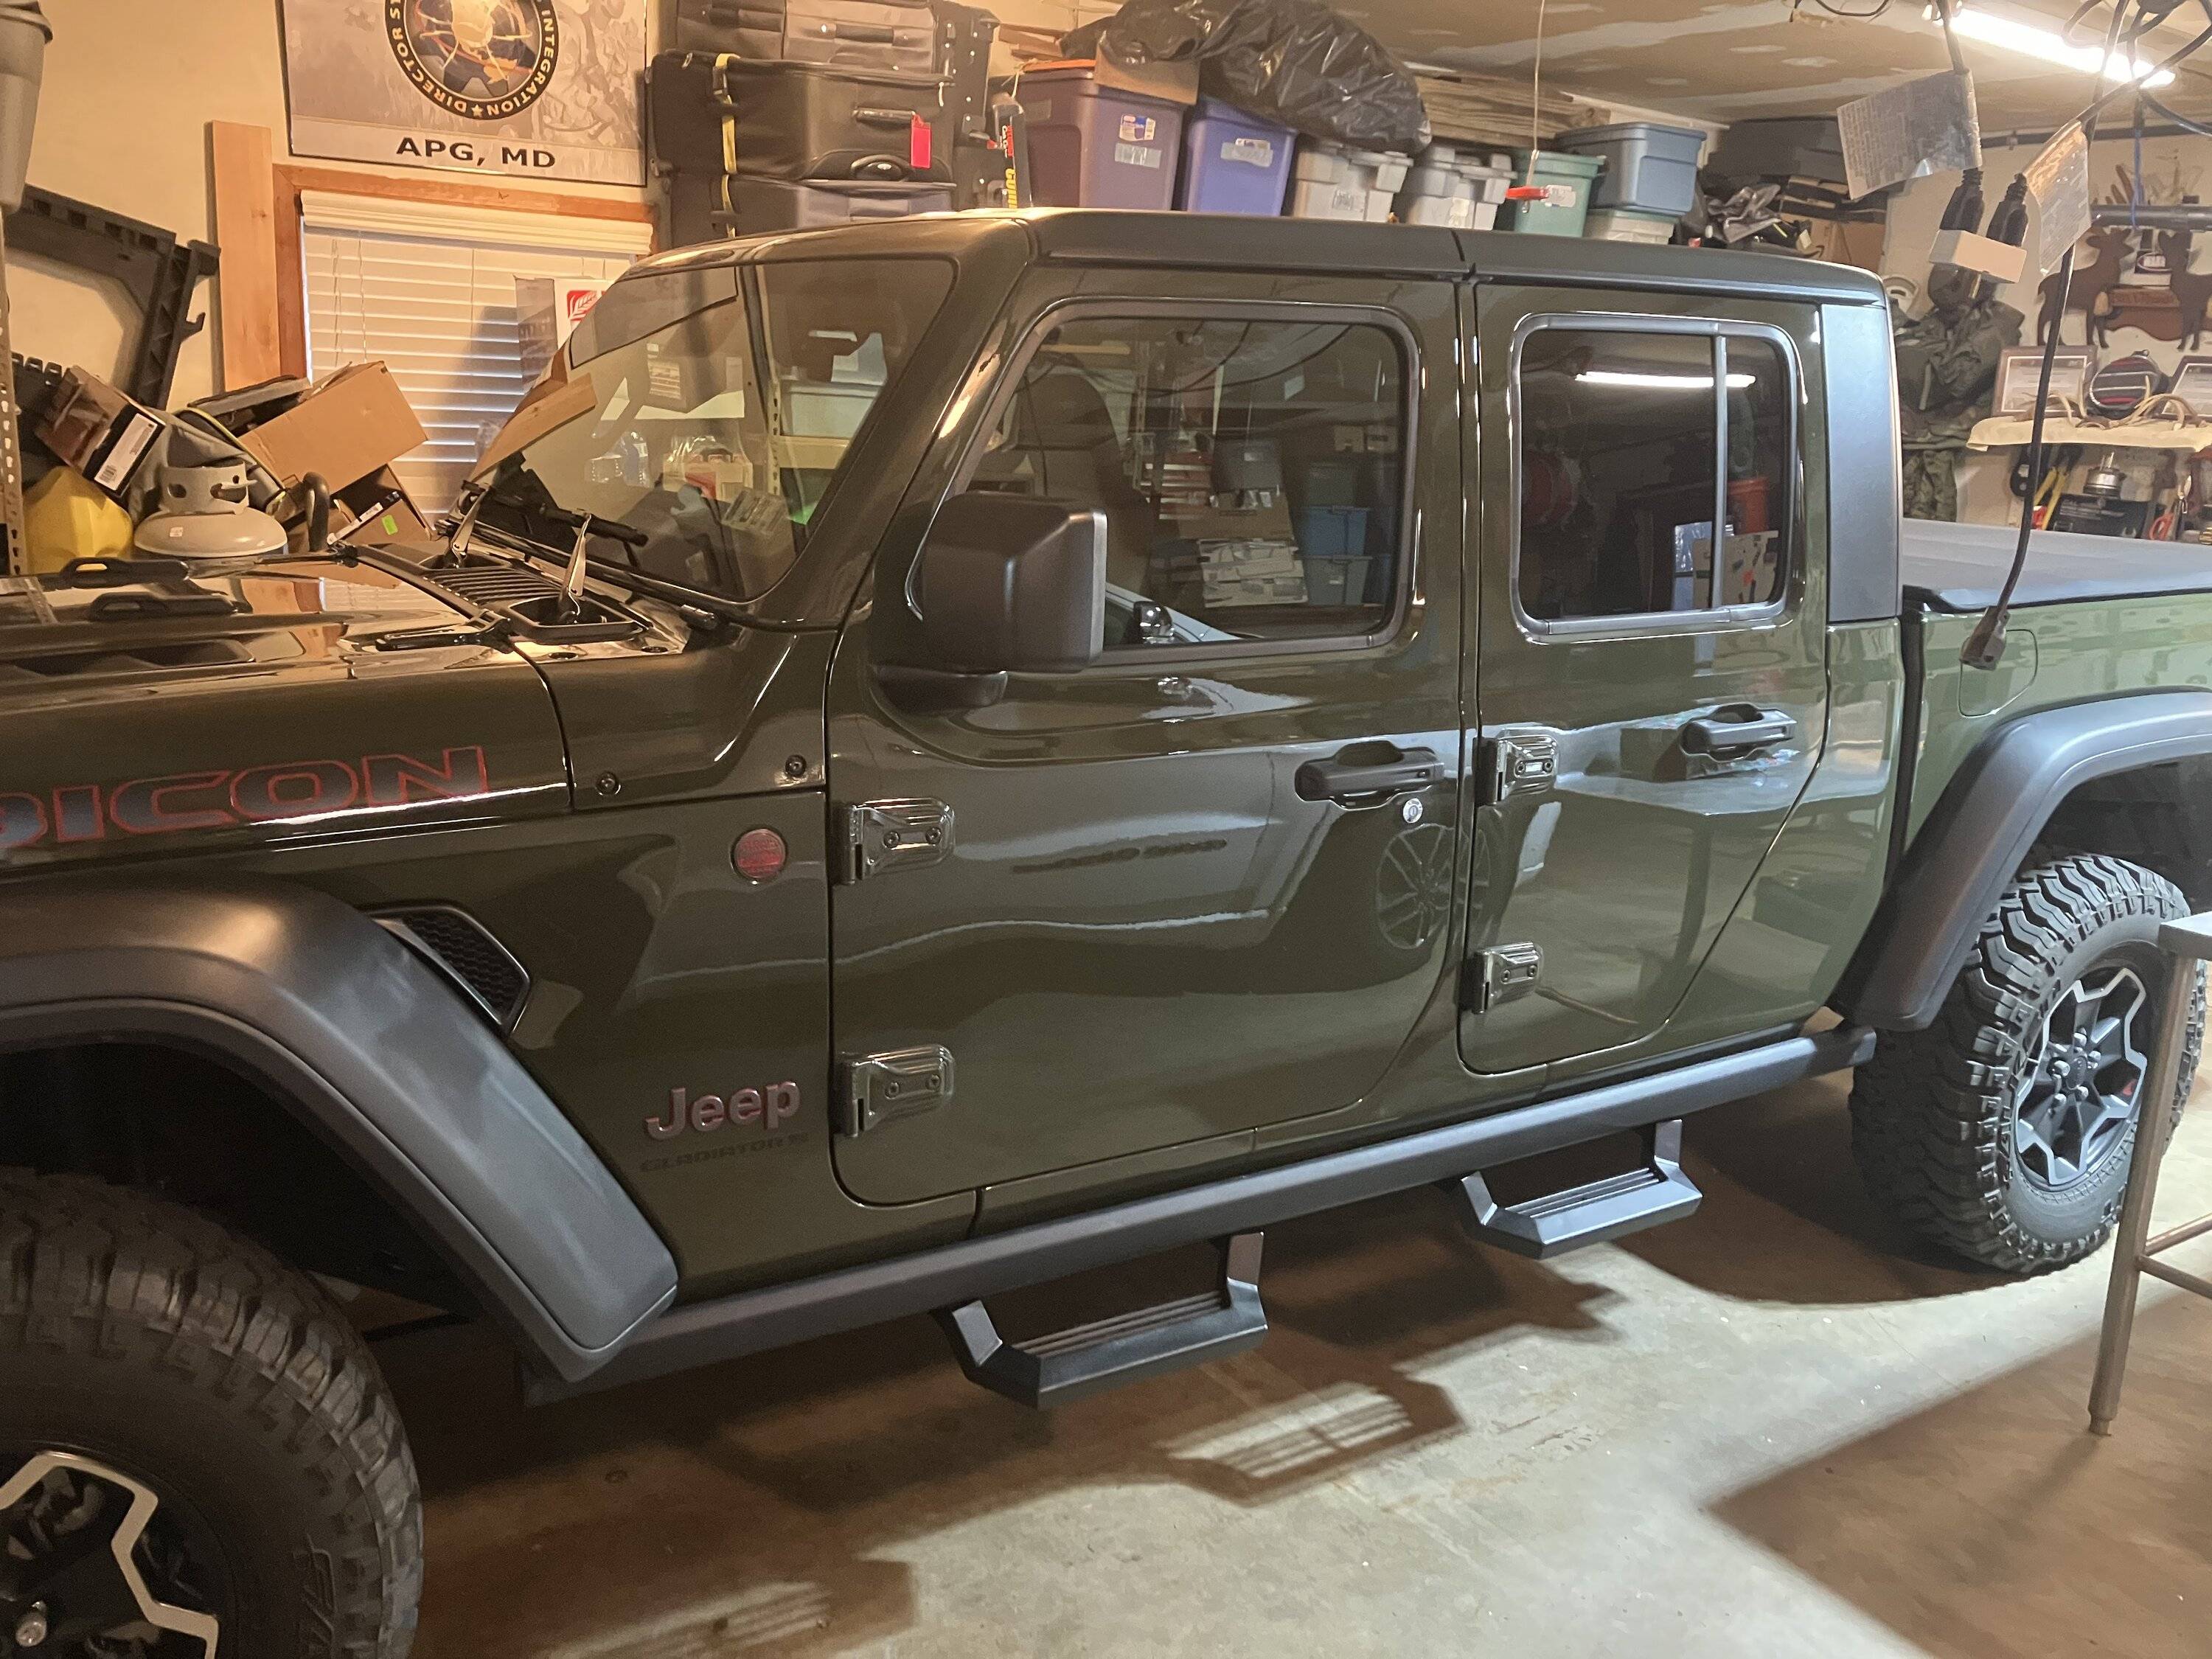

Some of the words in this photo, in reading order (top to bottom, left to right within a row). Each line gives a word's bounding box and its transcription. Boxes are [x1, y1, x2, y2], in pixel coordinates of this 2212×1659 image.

[392, 28, 467, 113] DIRECTOR
[487, 10, 556, 116] INTEGRATION
[396, 136, 485, 166] APG,
[501, 146, 557, 169] MD
[644, 1079, 801, 1141] Jeep
